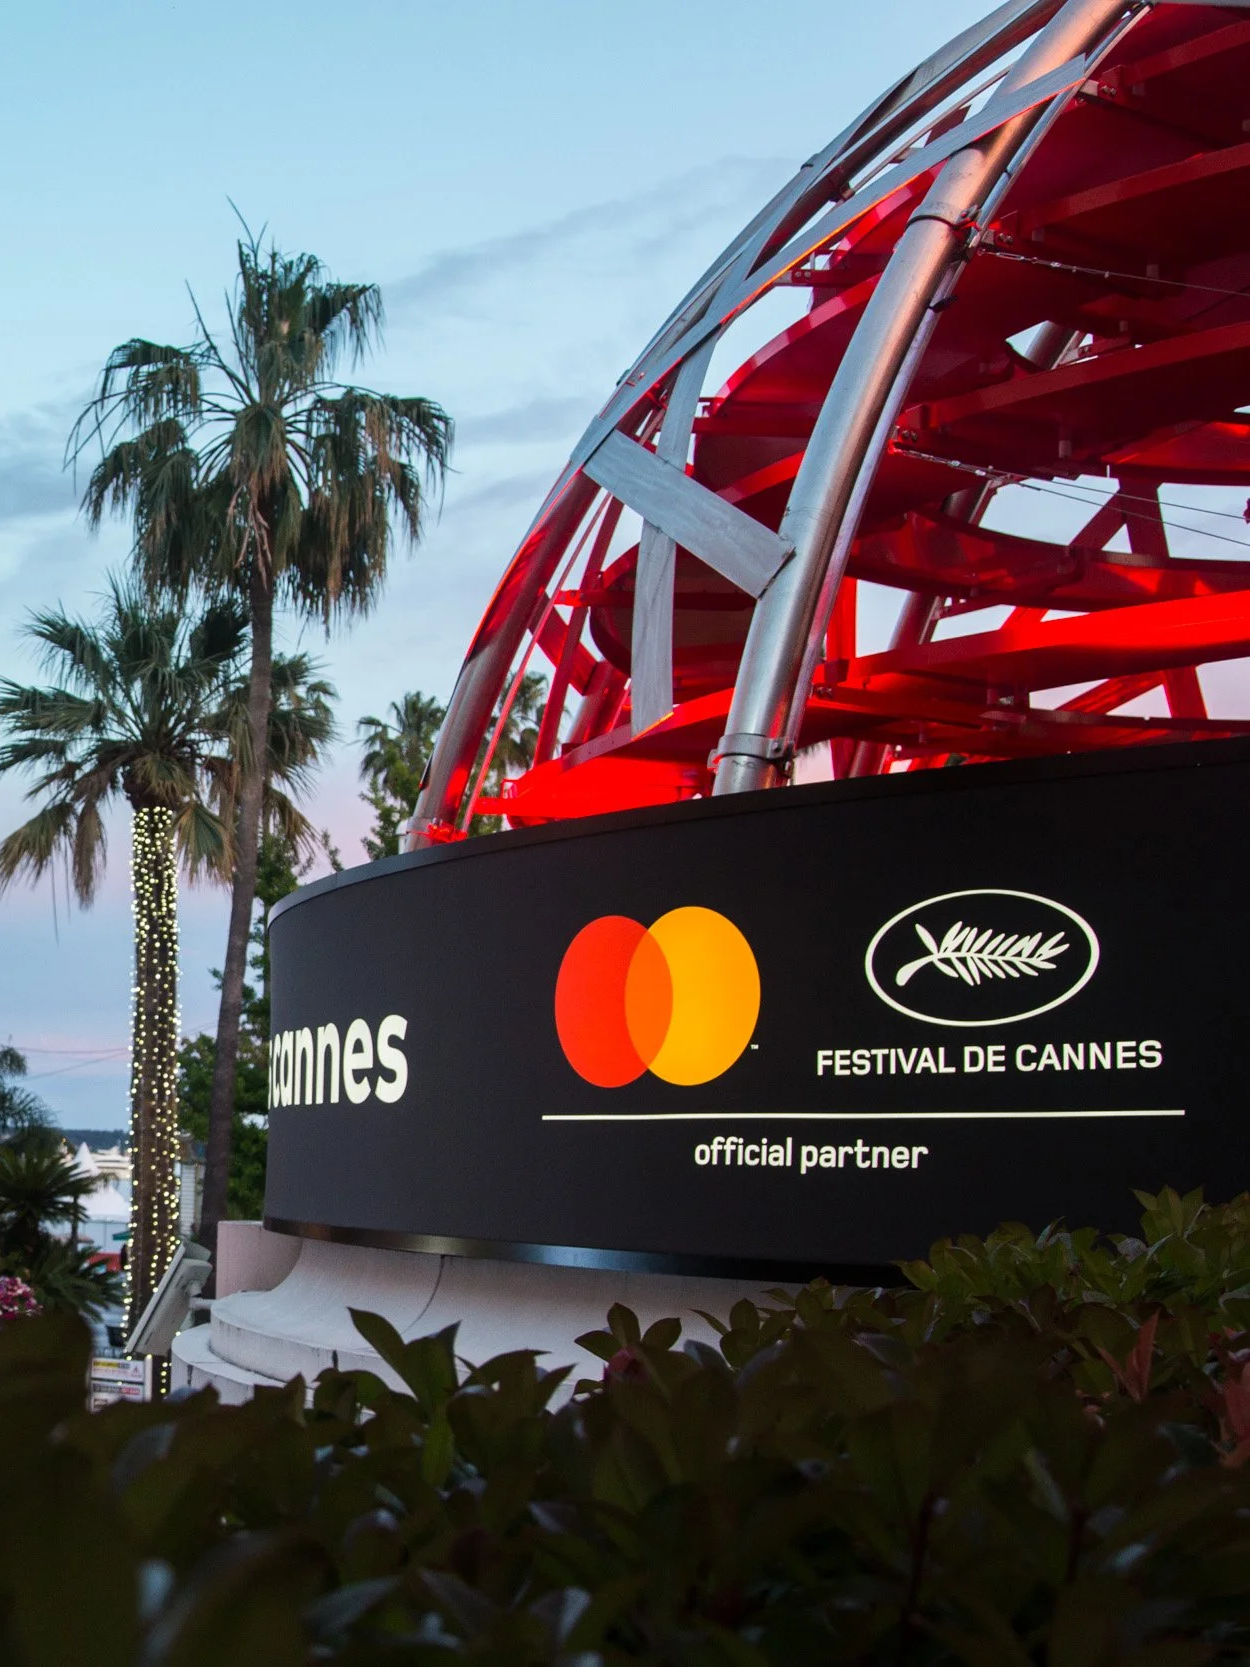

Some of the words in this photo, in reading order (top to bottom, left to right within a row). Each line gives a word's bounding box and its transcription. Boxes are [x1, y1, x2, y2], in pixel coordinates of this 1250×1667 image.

[268, 1014, 409, 1110] cannes
[817, 1044, 956, 1076] FESTIVAL
[963, 1043, 1006, 1073] DE
[1015, 1039, 1163, 1072] CANNES
[694, 1136, 793, 1168] official
[800, 1141, 929, 1175] partner
